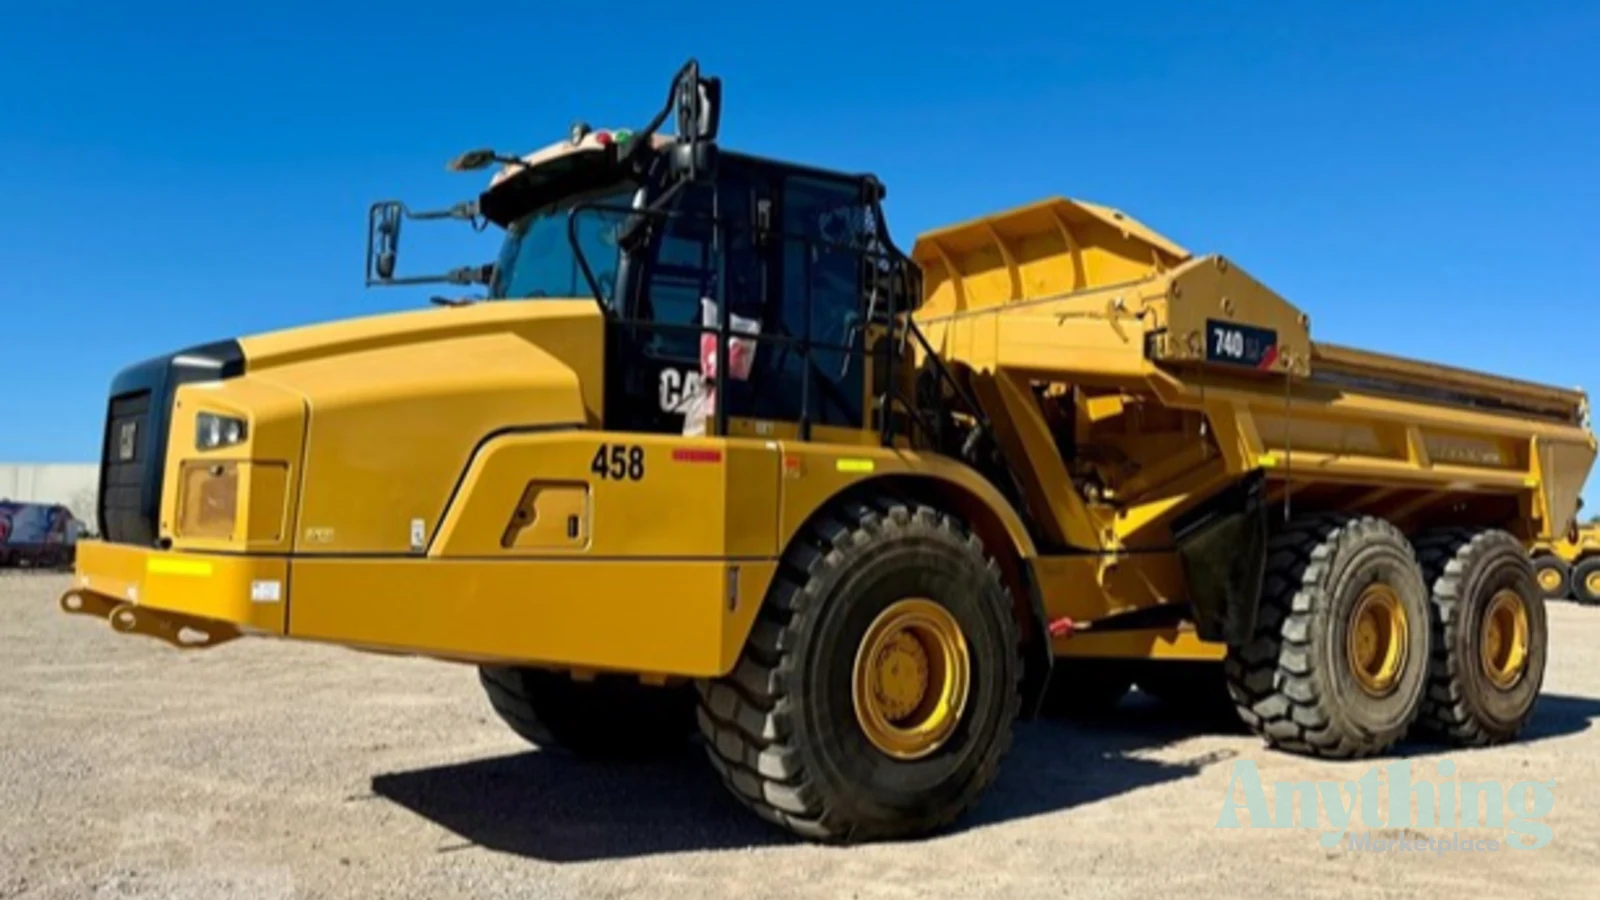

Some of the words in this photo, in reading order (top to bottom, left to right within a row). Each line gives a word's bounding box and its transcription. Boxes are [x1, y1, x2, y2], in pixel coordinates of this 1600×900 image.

[1213, 328, 1244, 358] 740
[658, 367, 703, 412] CA
[591, 444, 644, 480] 458
